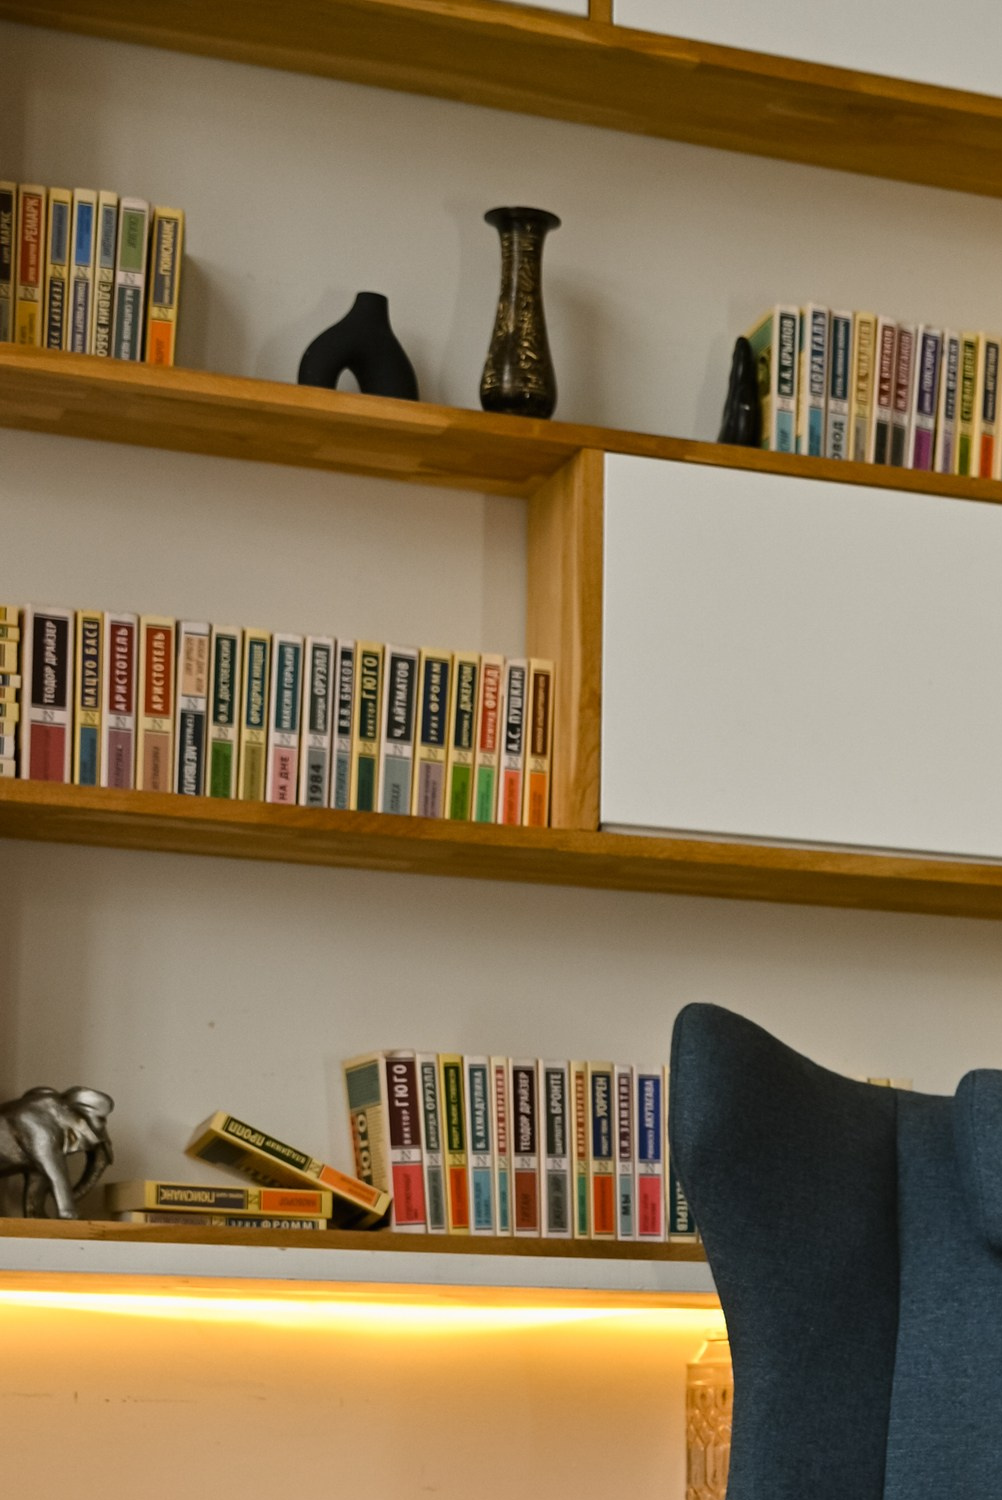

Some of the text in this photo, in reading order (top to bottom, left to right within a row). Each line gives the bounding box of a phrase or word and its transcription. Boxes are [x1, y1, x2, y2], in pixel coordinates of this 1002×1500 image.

[1, 211, 12, 245] МАРКС
[25, 198, 38, 242] РЕМАРК
[51, 282, 61, 327] ГЕРБЕРТ
[97, 284, 111, 357] ЭДВИН ЭББО
[780, 319, 794, 366] КРЫЛОВ
[43, 620, 58, 704] ТЕОДОР ДРАЙЗЕР
[84, 661, 99, 707] МАЦУО
[115, 628, 129, 711] АРИСТОТЕЛЬ
[151, 632, 166, 711] АРИСТОТЕЛЬ
[218, 639, 231, 701] ДОСТОЕВСКИЙ
[313, 650, 327, 696] ОРУЭЛЛ
[362, 656, 377, 700] ГЮГО
[392, 661, 409, 723] АЙТМАТОВ
[428, 663, 441, 713] ФРОММ
[509, 670, 523, 724] ПУШКИН
[278, 756, 289, 800] НА ДНЕ
[309, 764, 322, 803] 1984
[393, 1064, 411, 1145] ВИКТОР ГЮГО
[423, 1067, 436, 1111] ОРУЭЛЛ
[473, 1071, 486, 1137] АХМАДУЛИНА
[518, 1072, 531, 1151] ТЕОДОР ДРАЙЗЕР
[550, 1073, 562, 1114] БРОНТЕ
[595, 1077, 607, 1117] УОРРЕН
[228, 1121, 266, 1147] ПРОПП
[357, 1114, 372, 1177] ЮГО
[261, 1220, 313, 1229] ФРОММ
[622, 1194, 630, 1216] МЫ
